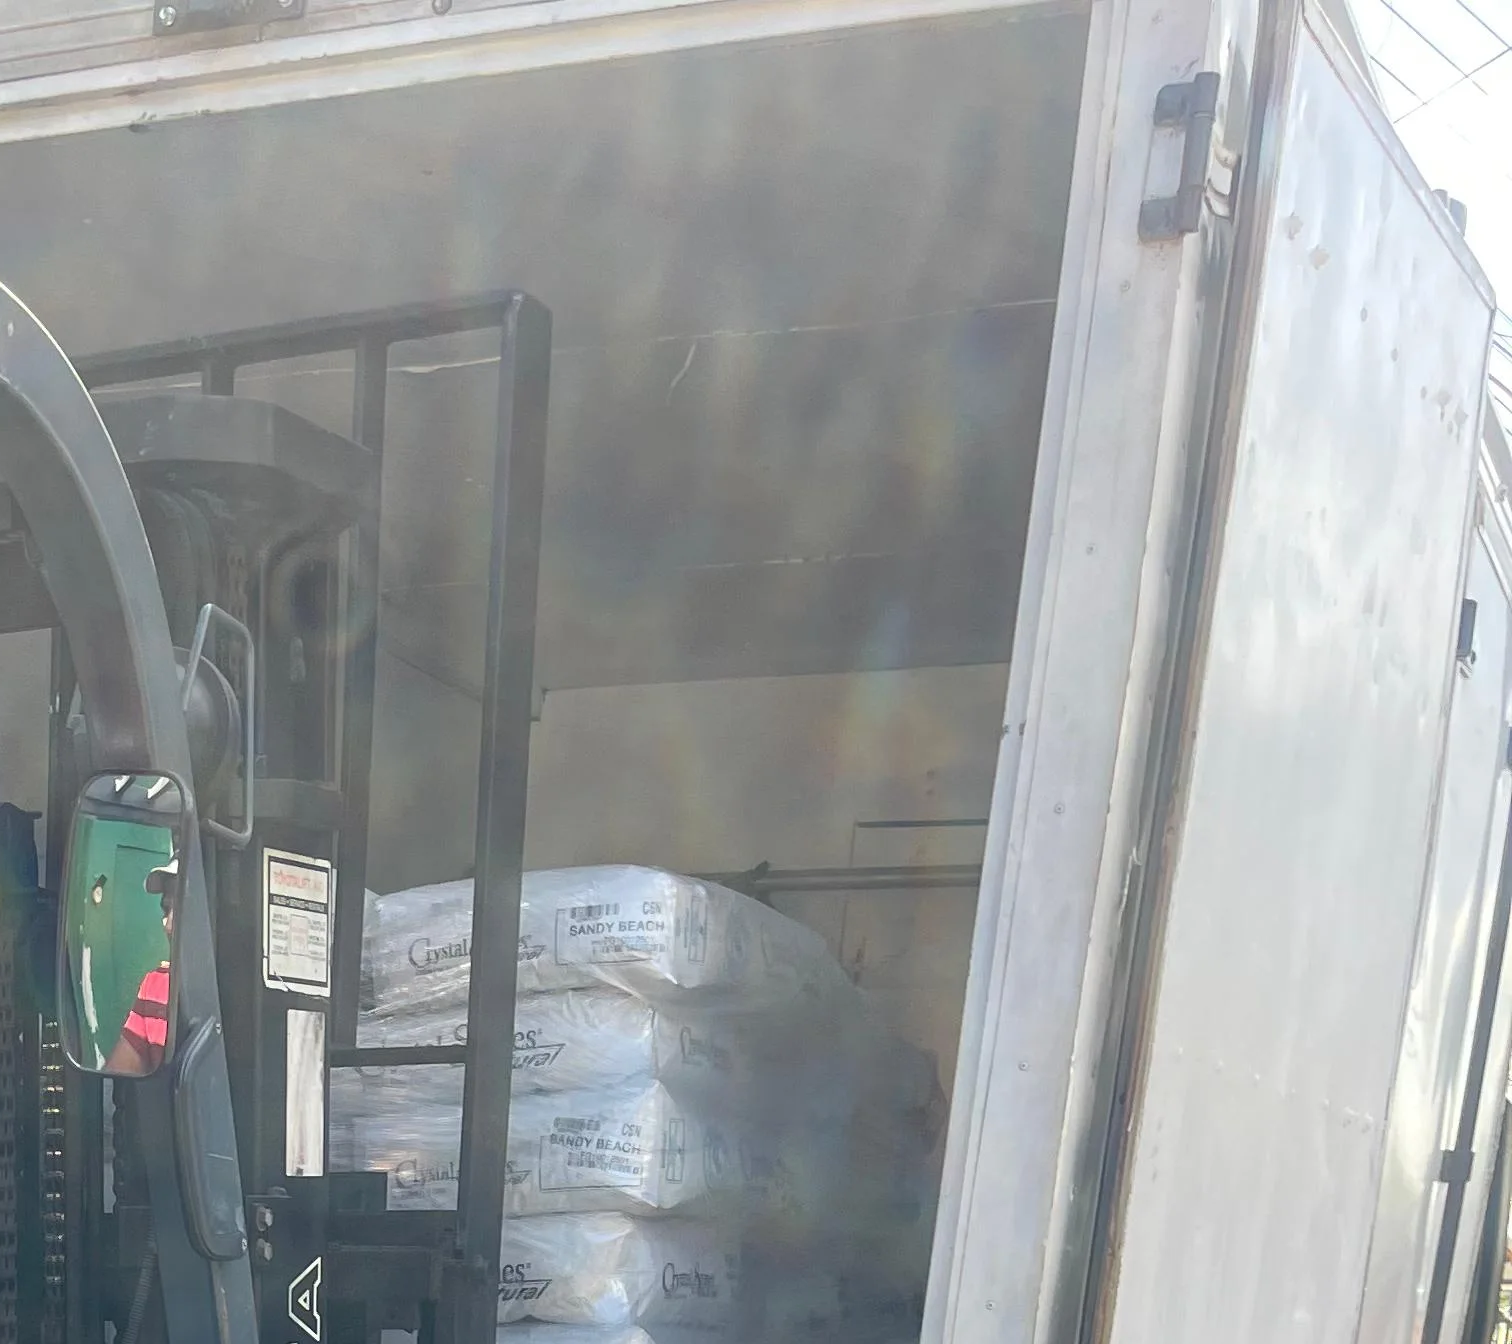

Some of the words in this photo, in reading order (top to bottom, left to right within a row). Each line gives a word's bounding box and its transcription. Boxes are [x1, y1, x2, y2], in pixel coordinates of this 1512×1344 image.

[569, 921, 615, 937] SANDY
[618, 920, 665, 933] BEACH
[549, 1133, 592, 1149] SANDY
[595, 1138, 641, 1155] BEACH
